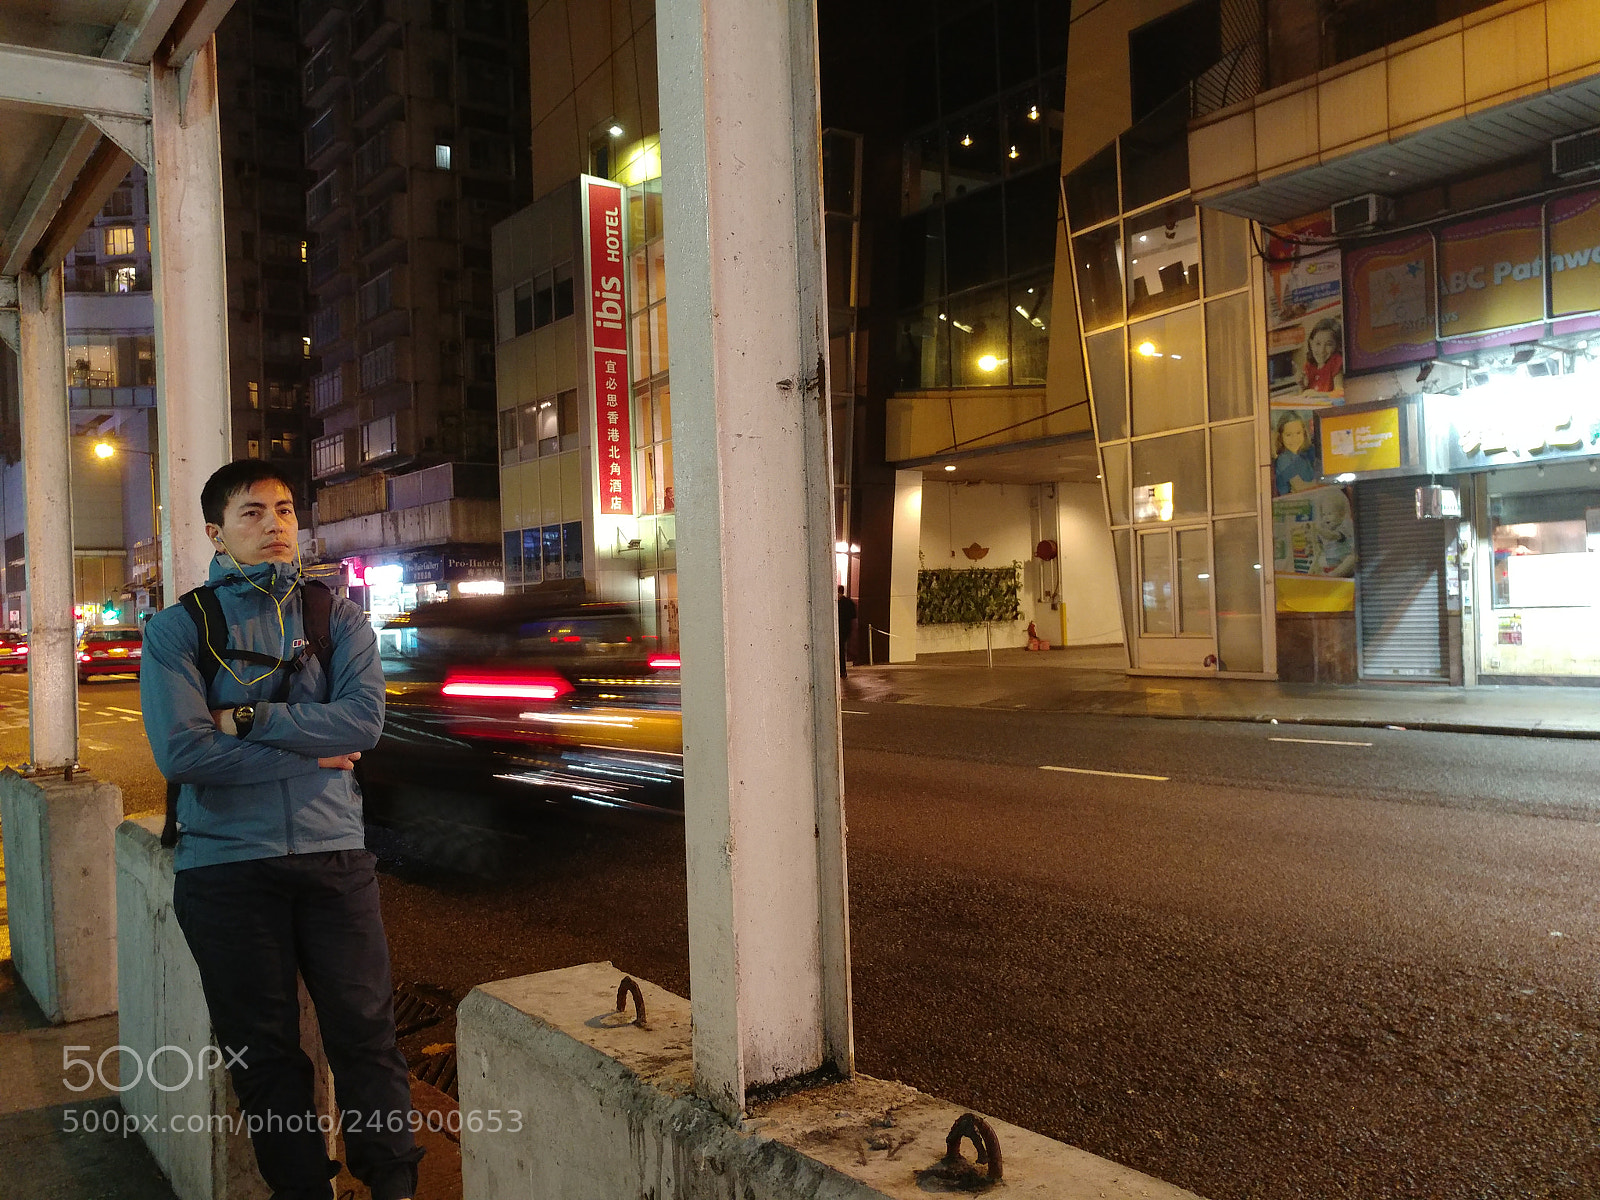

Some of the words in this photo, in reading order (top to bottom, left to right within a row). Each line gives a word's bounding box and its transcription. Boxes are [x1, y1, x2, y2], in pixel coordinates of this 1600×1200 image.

[605, 207, 620, 263] HOTEL
[595, 276, 622, 329] ibis
[605, 359, 622, 510] 宜必思香港北角酒店
